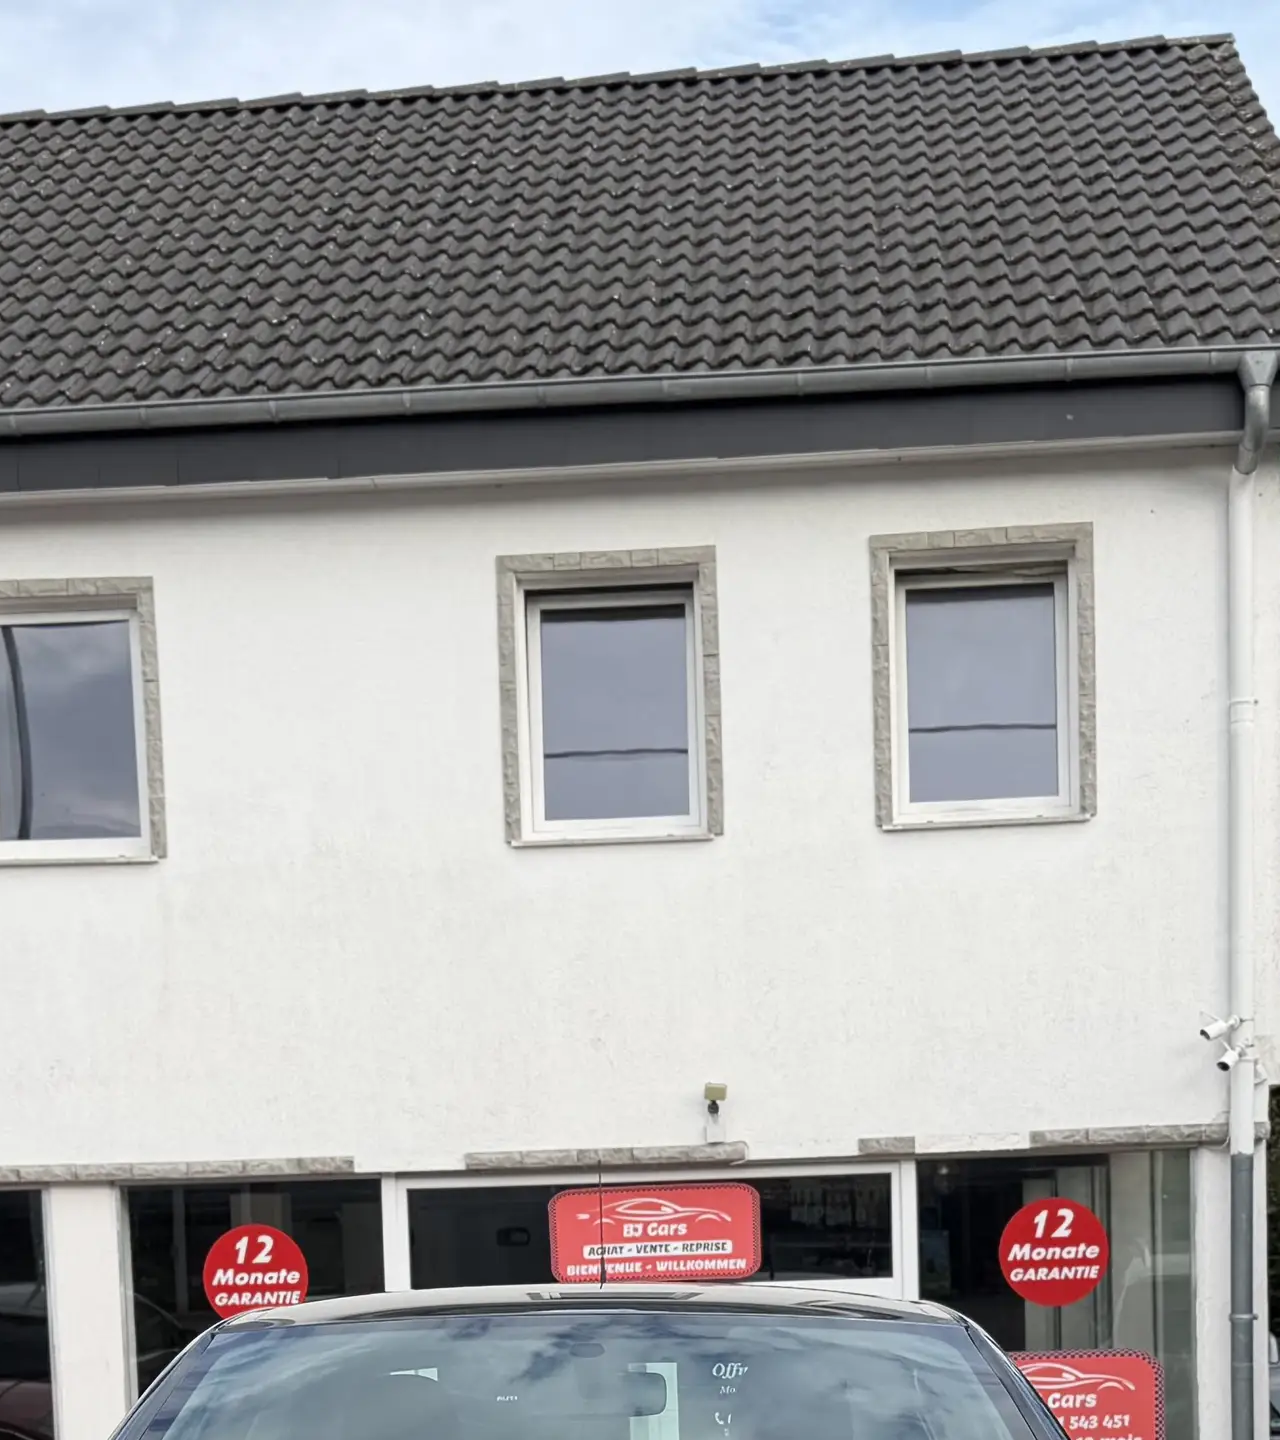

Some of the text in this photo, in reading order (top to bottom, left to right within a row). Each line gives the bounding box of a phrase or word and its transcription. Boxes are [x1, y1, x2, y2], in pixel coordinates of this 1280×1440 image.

[647, 1222, 688, 1236] Cars
[1033, 1208, 1074, 1239] 12
[235, 1235, 274, 1265] 12
[636, 1243, 671, 1254] VENTE
[682, 1242, 727, 1252] REPRISE
[1007, 1242, 1100, 1262] Monate
[566, 1262, 642, 1276] BIENENUE
[655, 1258, 747, 1272] WILLKOMMEN
[1010, 1265, 1100, 1282] GARANTIE
[212, 1268, 301, 1287] Monate
[214, 1291, 301, 1307] GARANTIE
[1047, 1392, 1097, 1409] Cars
[1069, 1415, 1098, 1430] 543
[1102, 1413, 1130, 1429] 451
